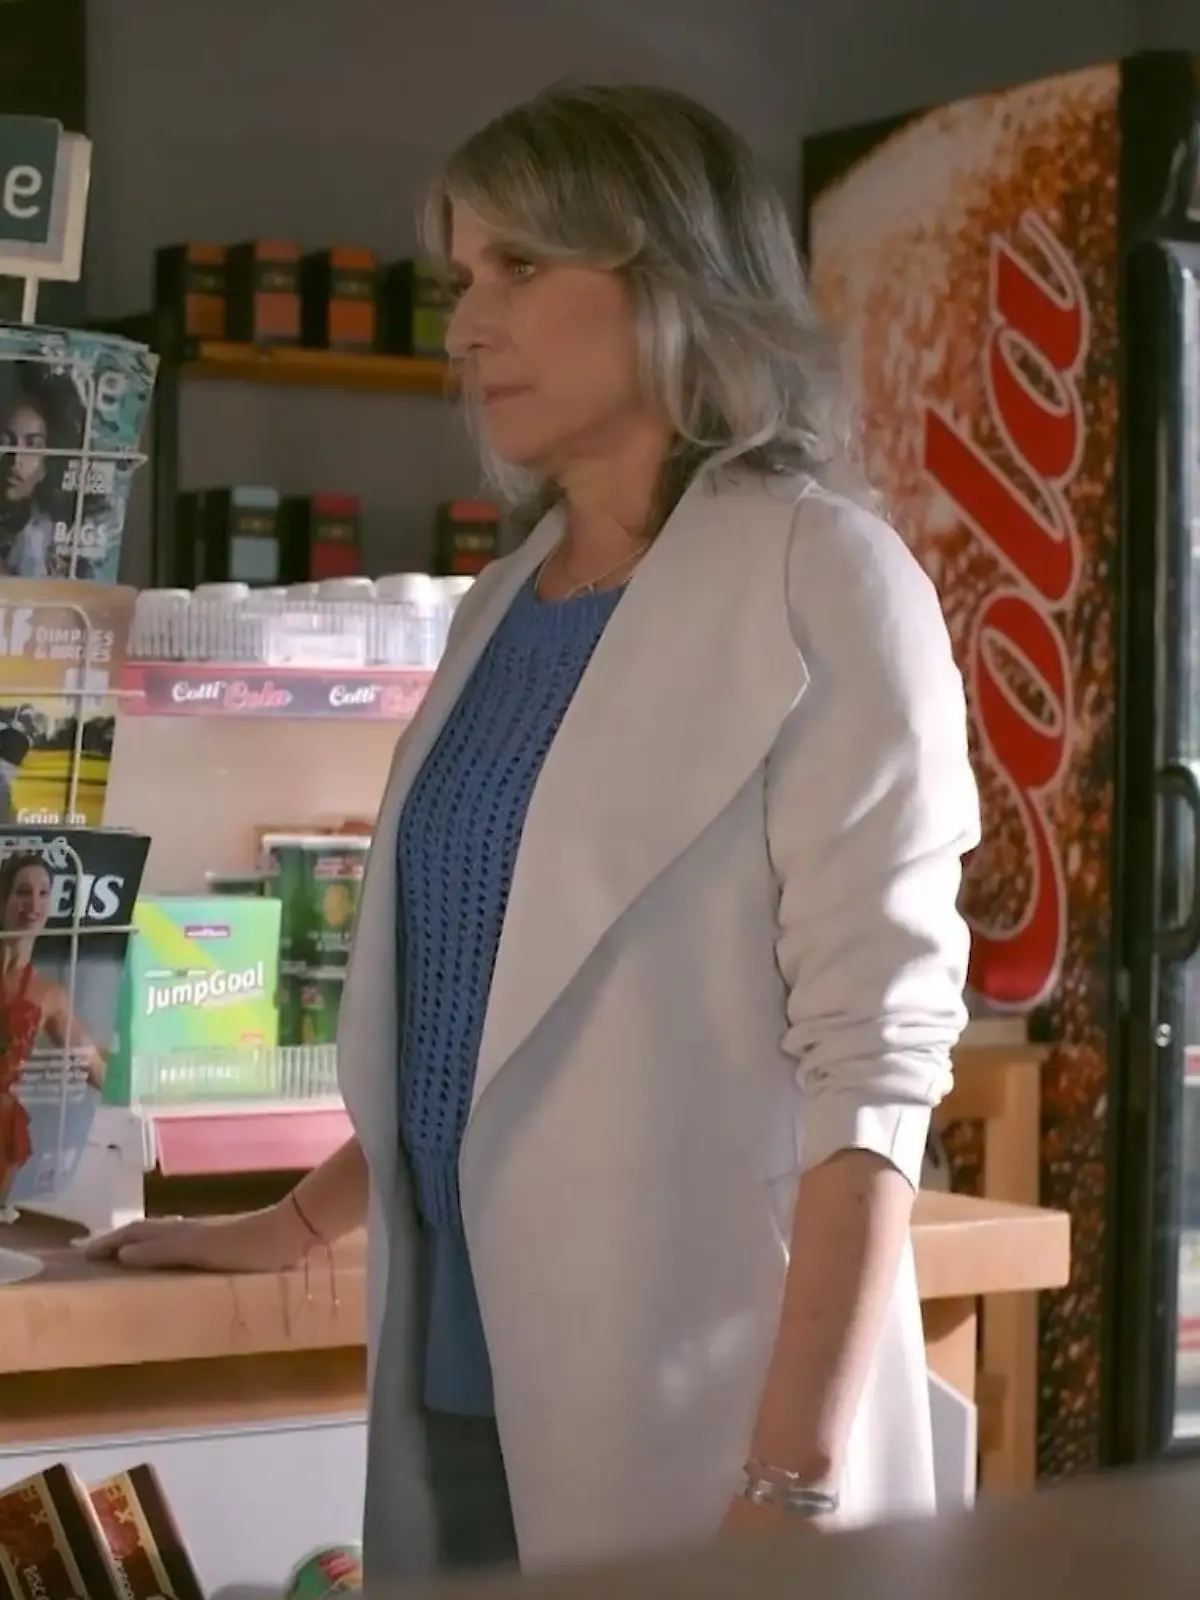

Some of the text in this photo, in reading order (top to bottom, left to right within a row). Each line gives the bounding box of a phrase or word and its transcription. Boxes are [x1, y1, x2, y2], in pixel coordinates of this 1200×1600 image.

[3, 165, 43, 219] e
[921, 211, 1090, 1006] Cola
[145, 960, 265, 1015] JumpGoal
